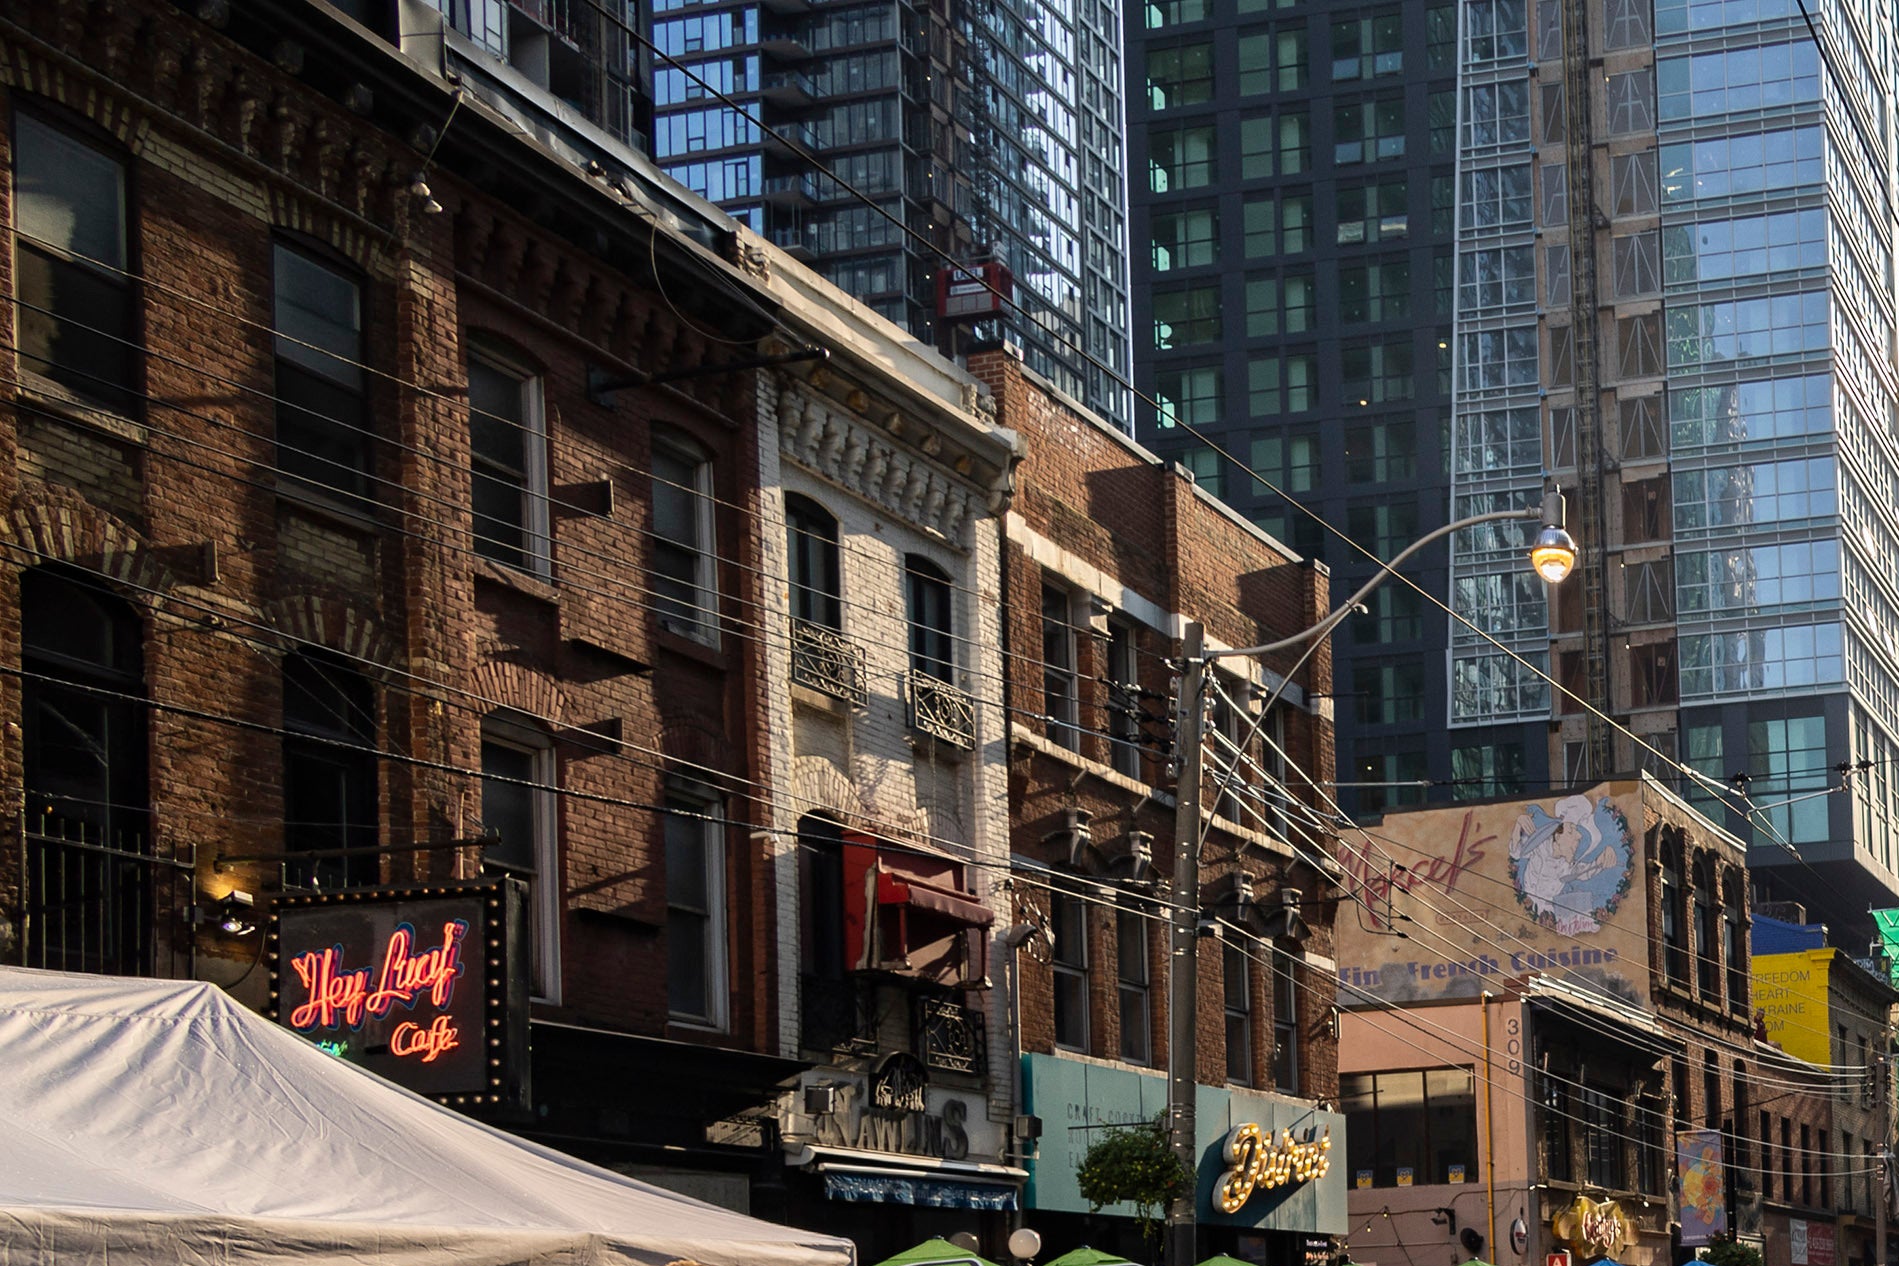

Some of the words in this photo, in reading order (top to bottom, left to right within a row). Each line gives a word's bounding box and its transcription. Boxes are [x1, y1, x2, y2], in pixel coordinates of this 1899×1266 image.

[291, 946, 371, 1029] Hey
[366, 922, 463, 1008] Lucy
[1340, 966, 1379, 987] Fin
[1407, 954, 1499, 982] French
[1510, 946, 1618, 973] Cuisine
[1507, 1018, 1521, 1076] 309
